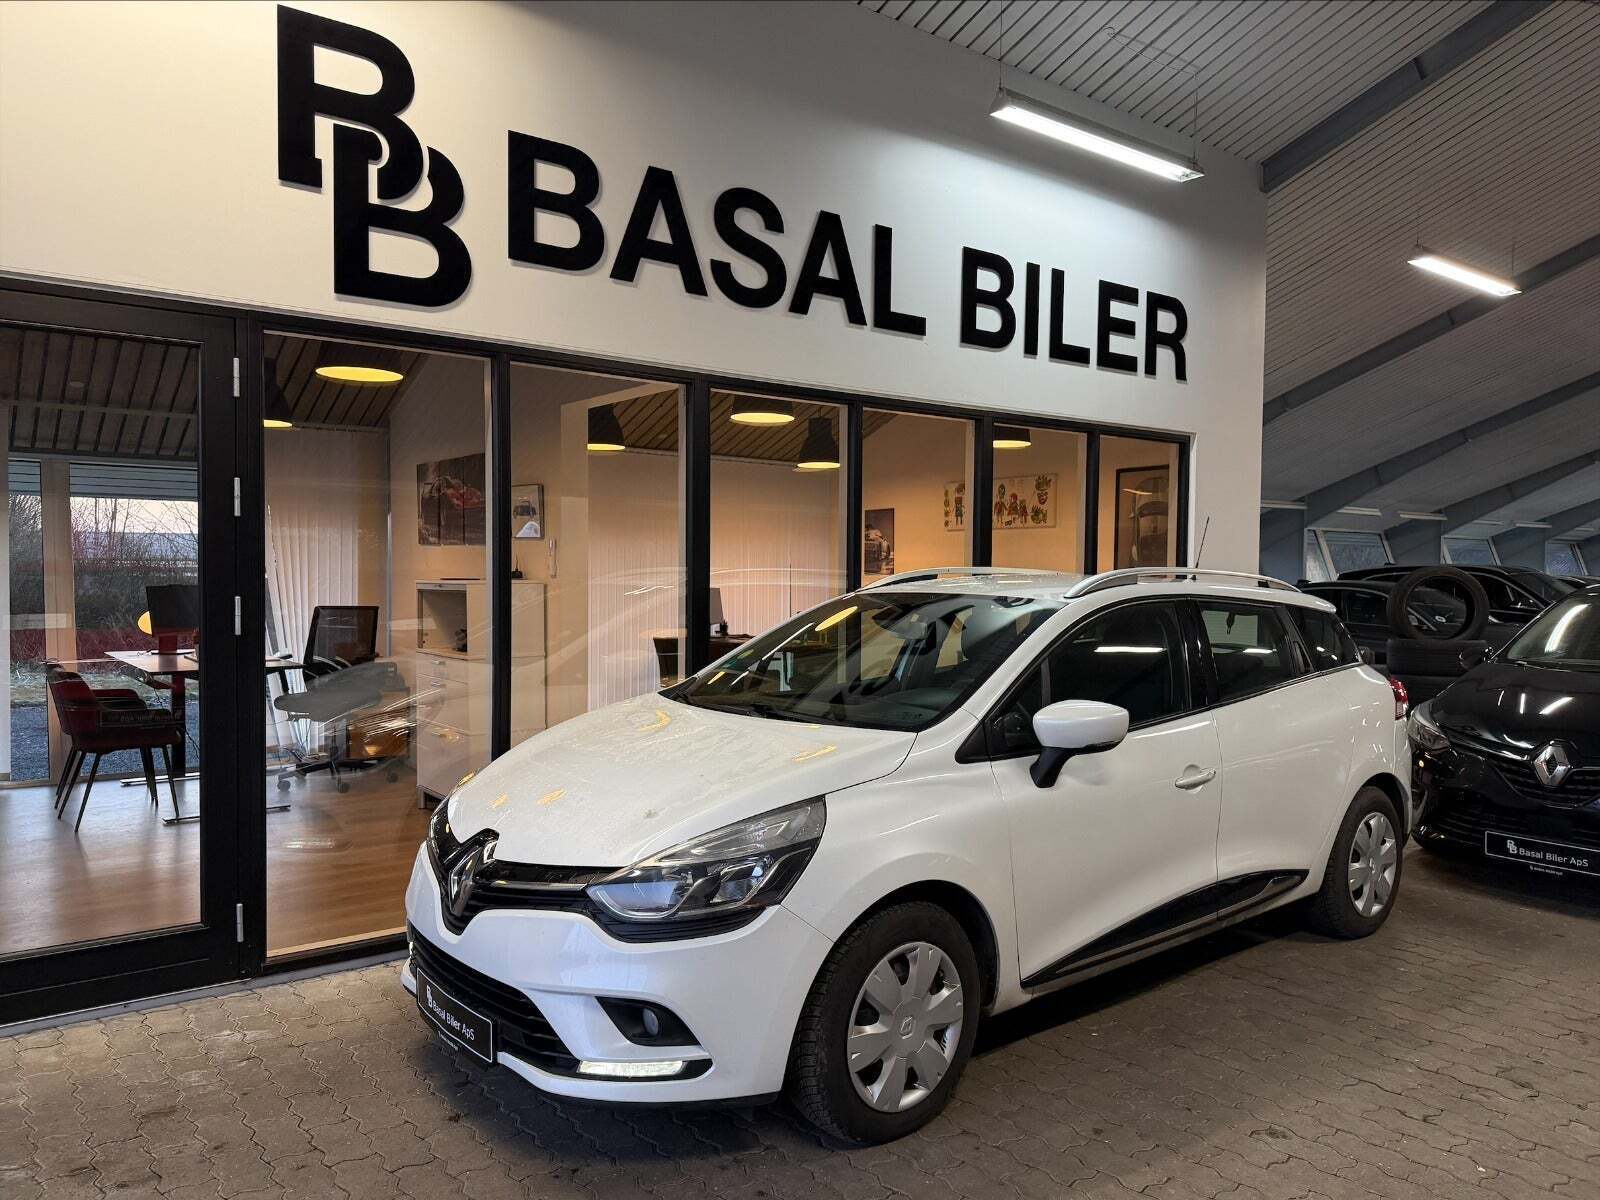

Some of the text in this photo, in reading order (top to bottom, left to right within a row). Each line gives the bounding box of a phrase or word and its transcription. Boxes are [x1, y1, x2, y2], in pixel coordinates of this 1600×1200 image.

[508, 130, 1188, 380] BASAL BILER
[1519, 847, 1543, 859] Basal
[1545, 852, 1568, 863] Biler
[1569, 857, 1589, 867] ApS
[433, 1001, 446, 1020] Basal
[446, 1012, 460, 1030] Biler
[462, 1024, 475, 1040] ApS
